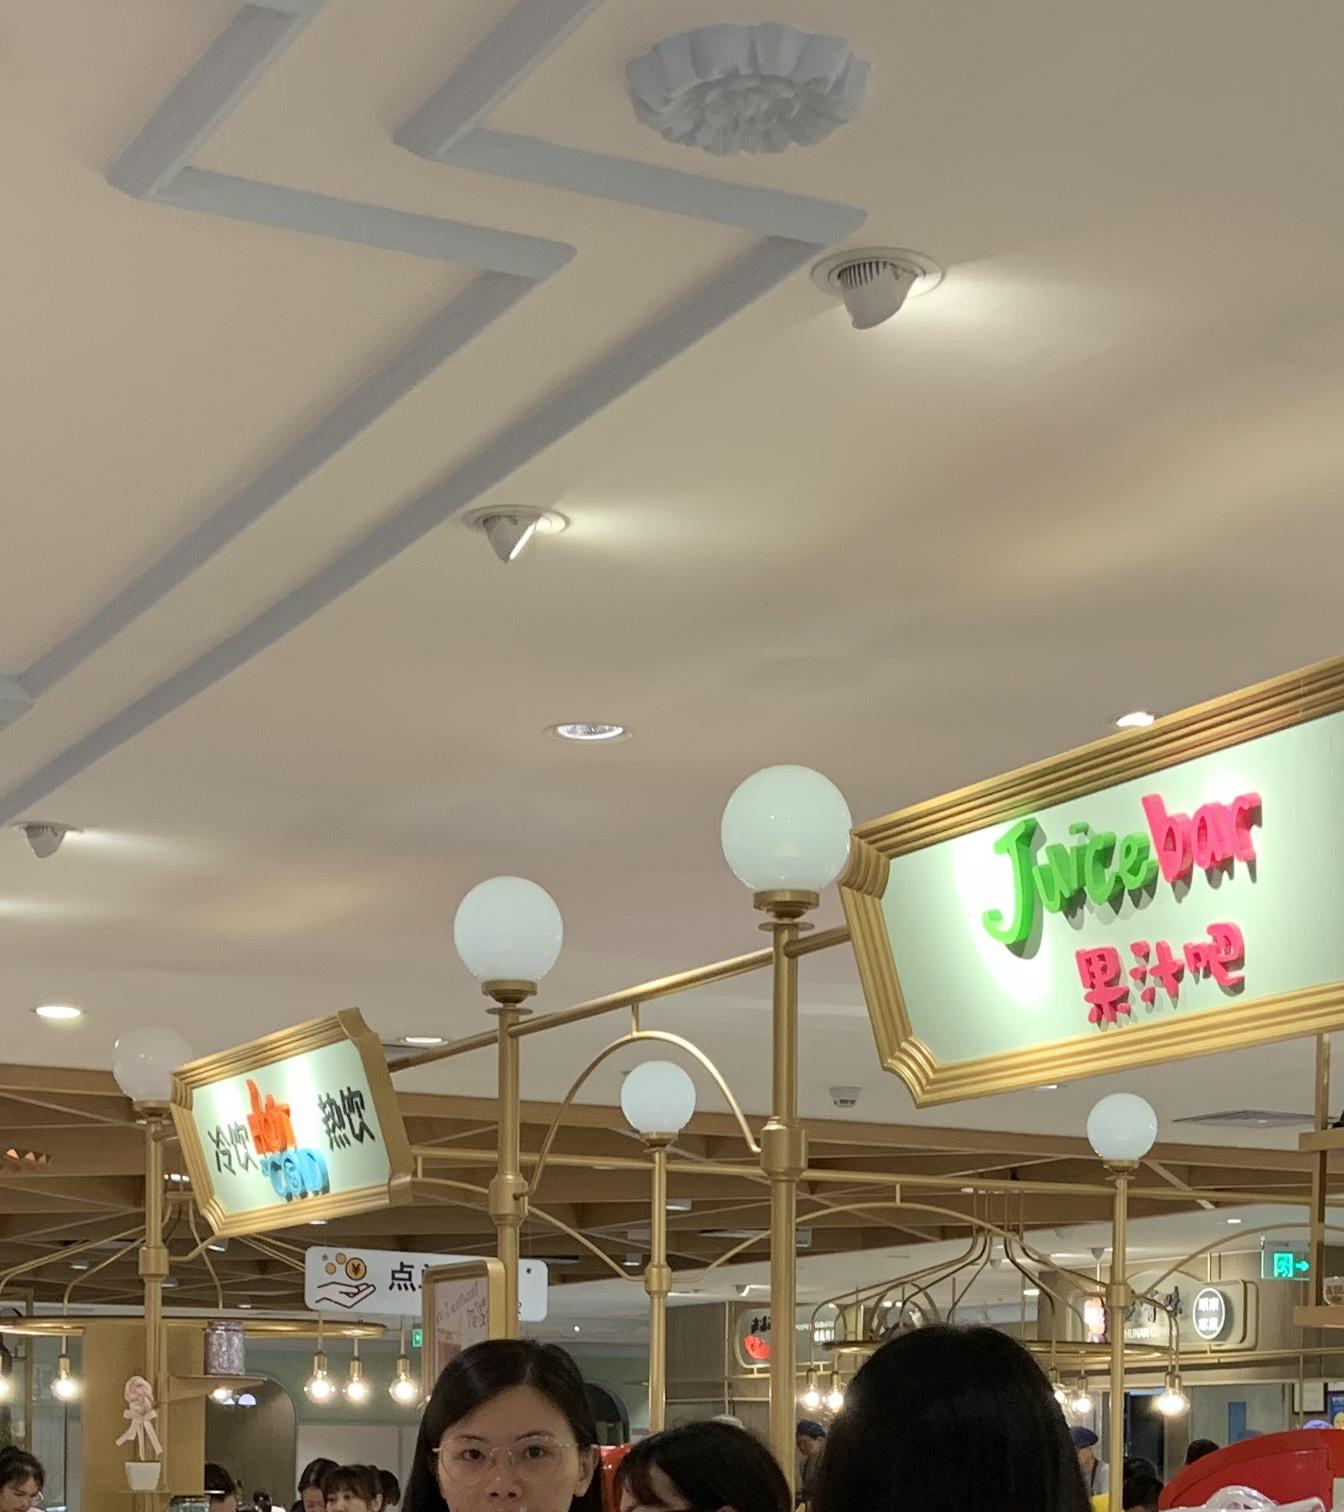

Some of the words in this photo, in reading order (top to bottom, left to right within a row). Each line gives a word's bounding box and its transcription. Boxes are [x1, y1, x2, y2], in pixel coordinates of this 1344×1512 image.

[1075, 921, 1246, 1029] 果汁吧
[208, 1120, 258, 1176] 冷饮
[318, 1086, 375, 1151] 热饮
